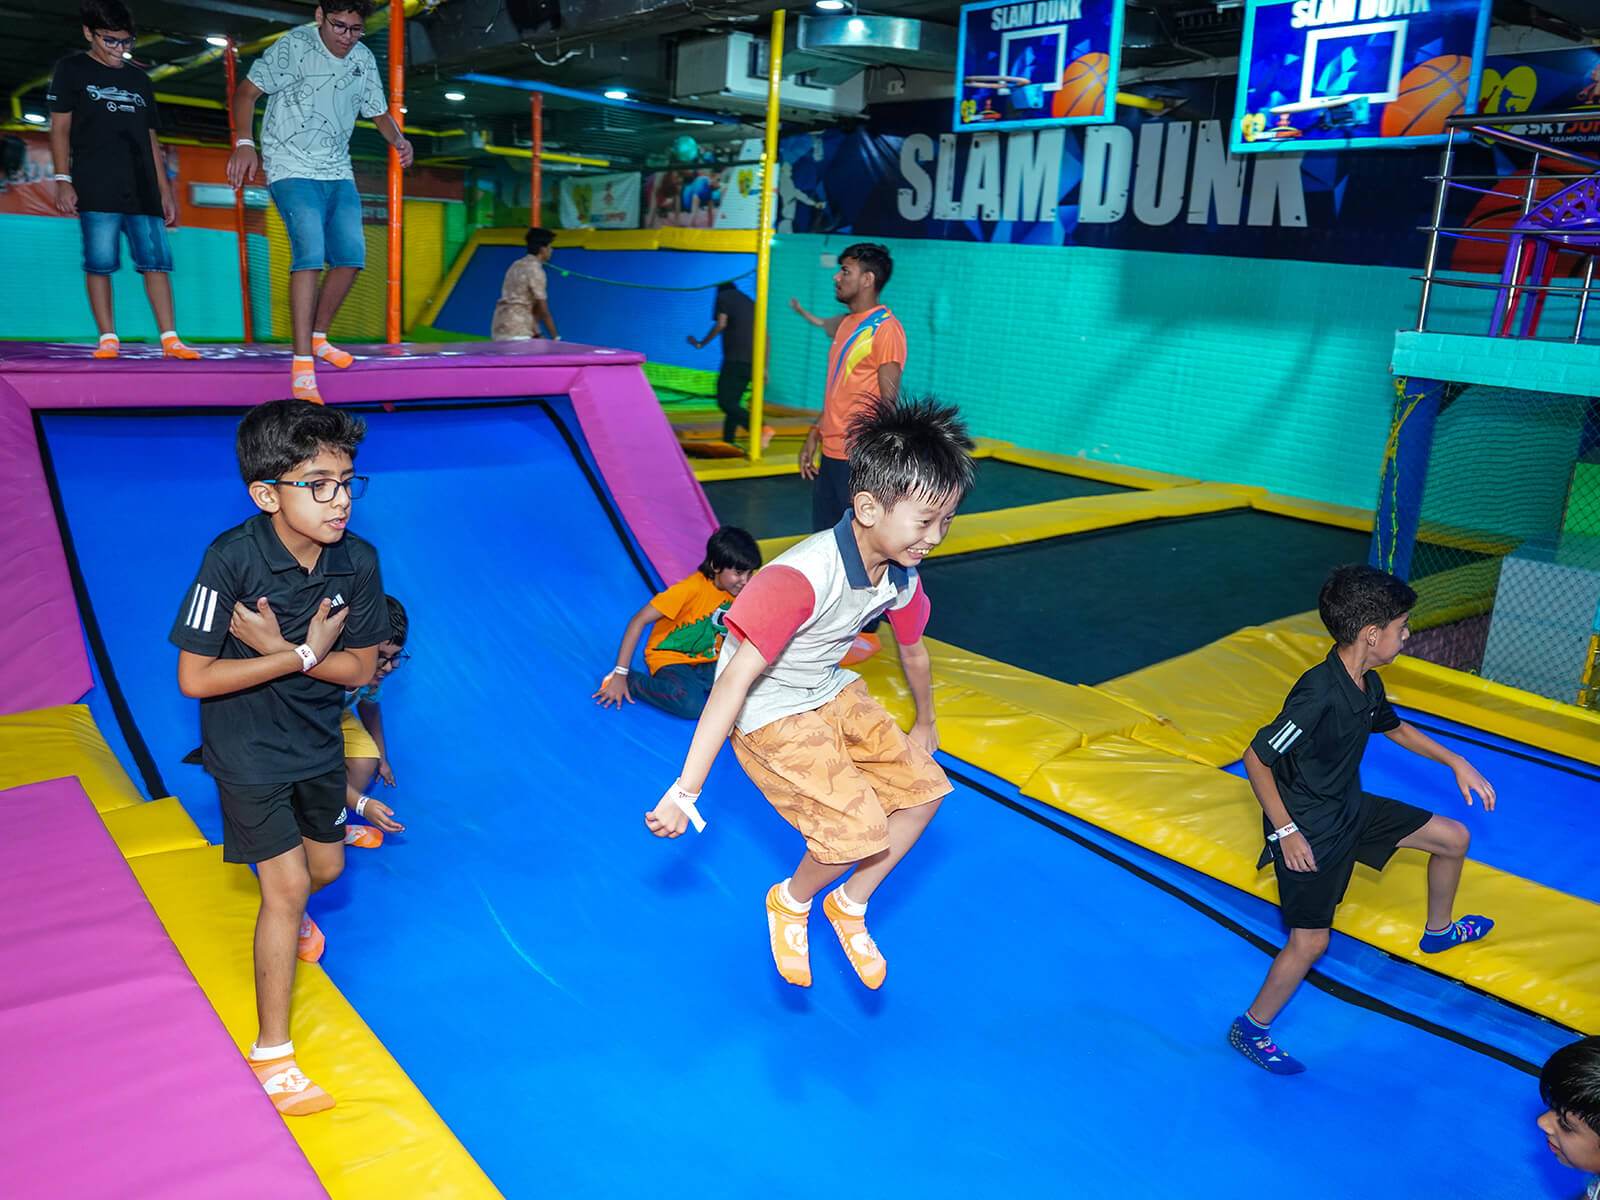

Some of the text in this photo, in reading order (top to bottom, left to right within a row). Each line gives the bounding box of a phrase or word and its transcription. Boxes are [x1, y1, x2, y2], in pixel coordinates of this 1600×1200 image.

[991, 0, 1082, 31] SLAM DUNK
[1290, 0, 1355, 29] SLAM
[897, 119, 1308, 228] SLAM DUNK
